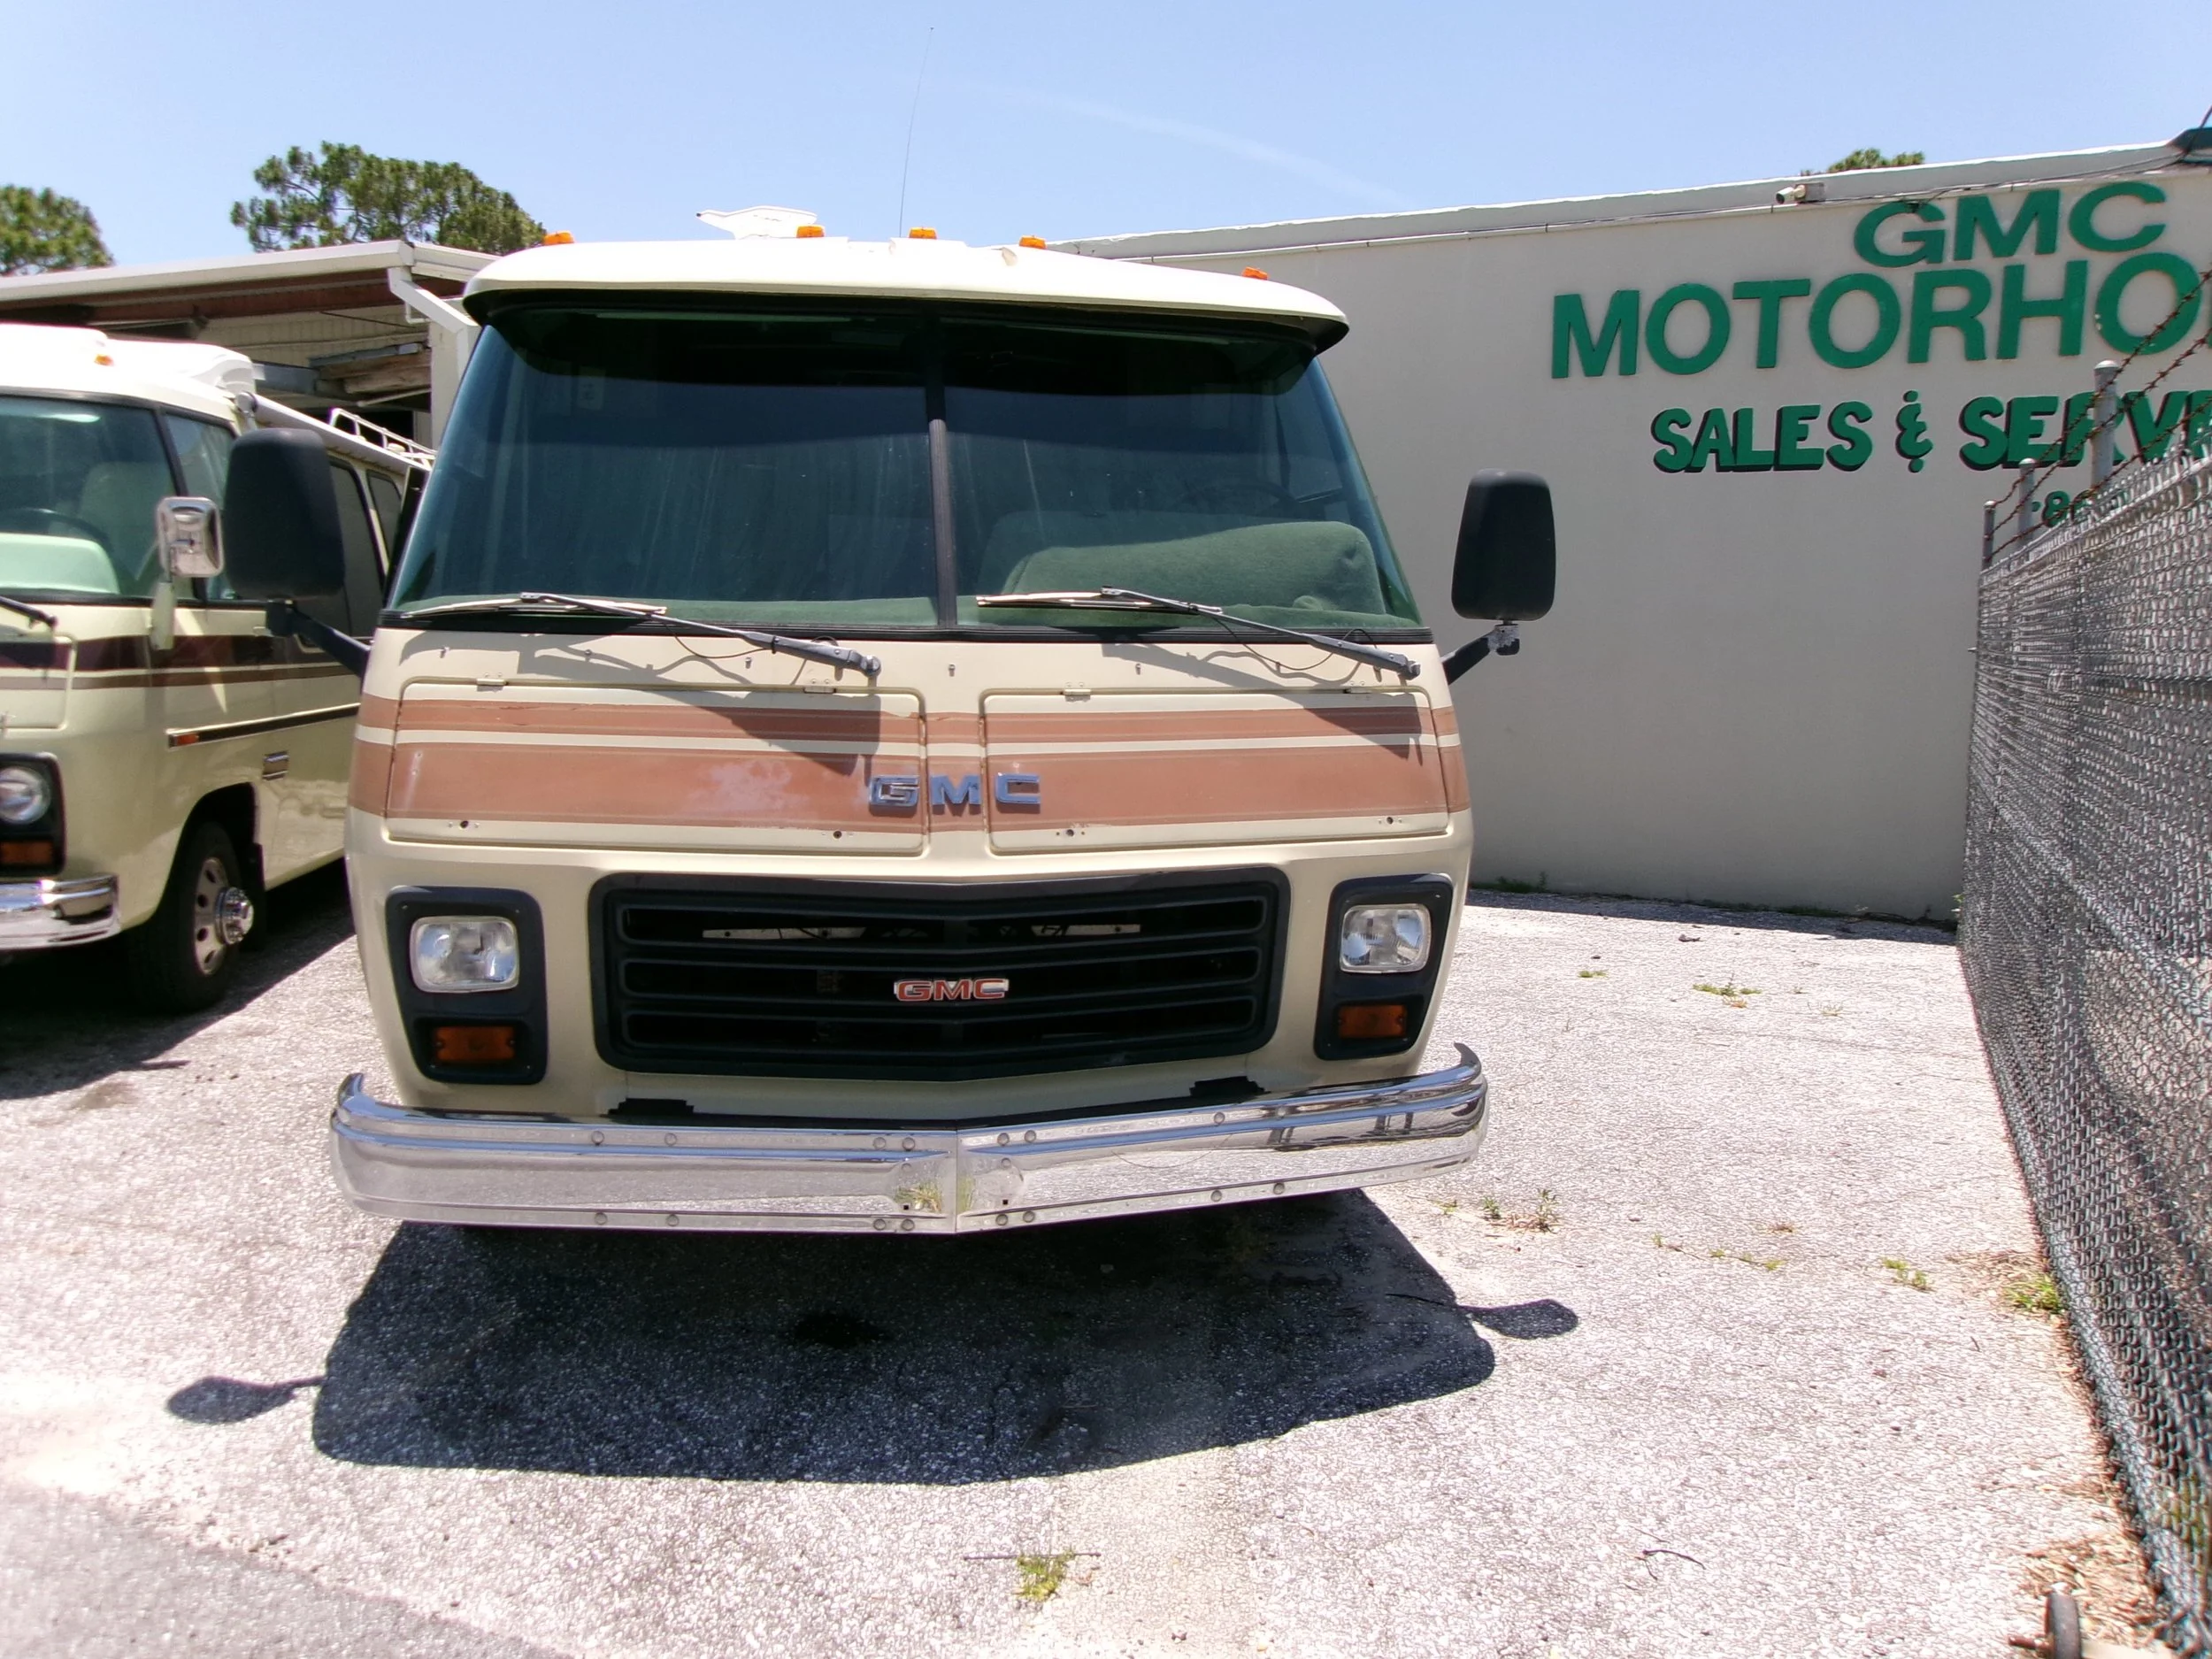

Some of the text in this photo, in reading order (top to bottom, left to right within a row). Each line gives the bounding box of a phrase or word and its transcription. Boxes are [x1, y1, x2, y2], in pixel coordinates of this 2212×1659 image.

[1854, 181, 2167, 268] GMC
[1551, 251, 2212, 379] MOTORHO
[1650, 401, 1874, 473] SALES
[1894, 390, 1934, 473] &
[869, 772, 1041, 807] GMC
[894, 978, 1010, 1002] GMC
